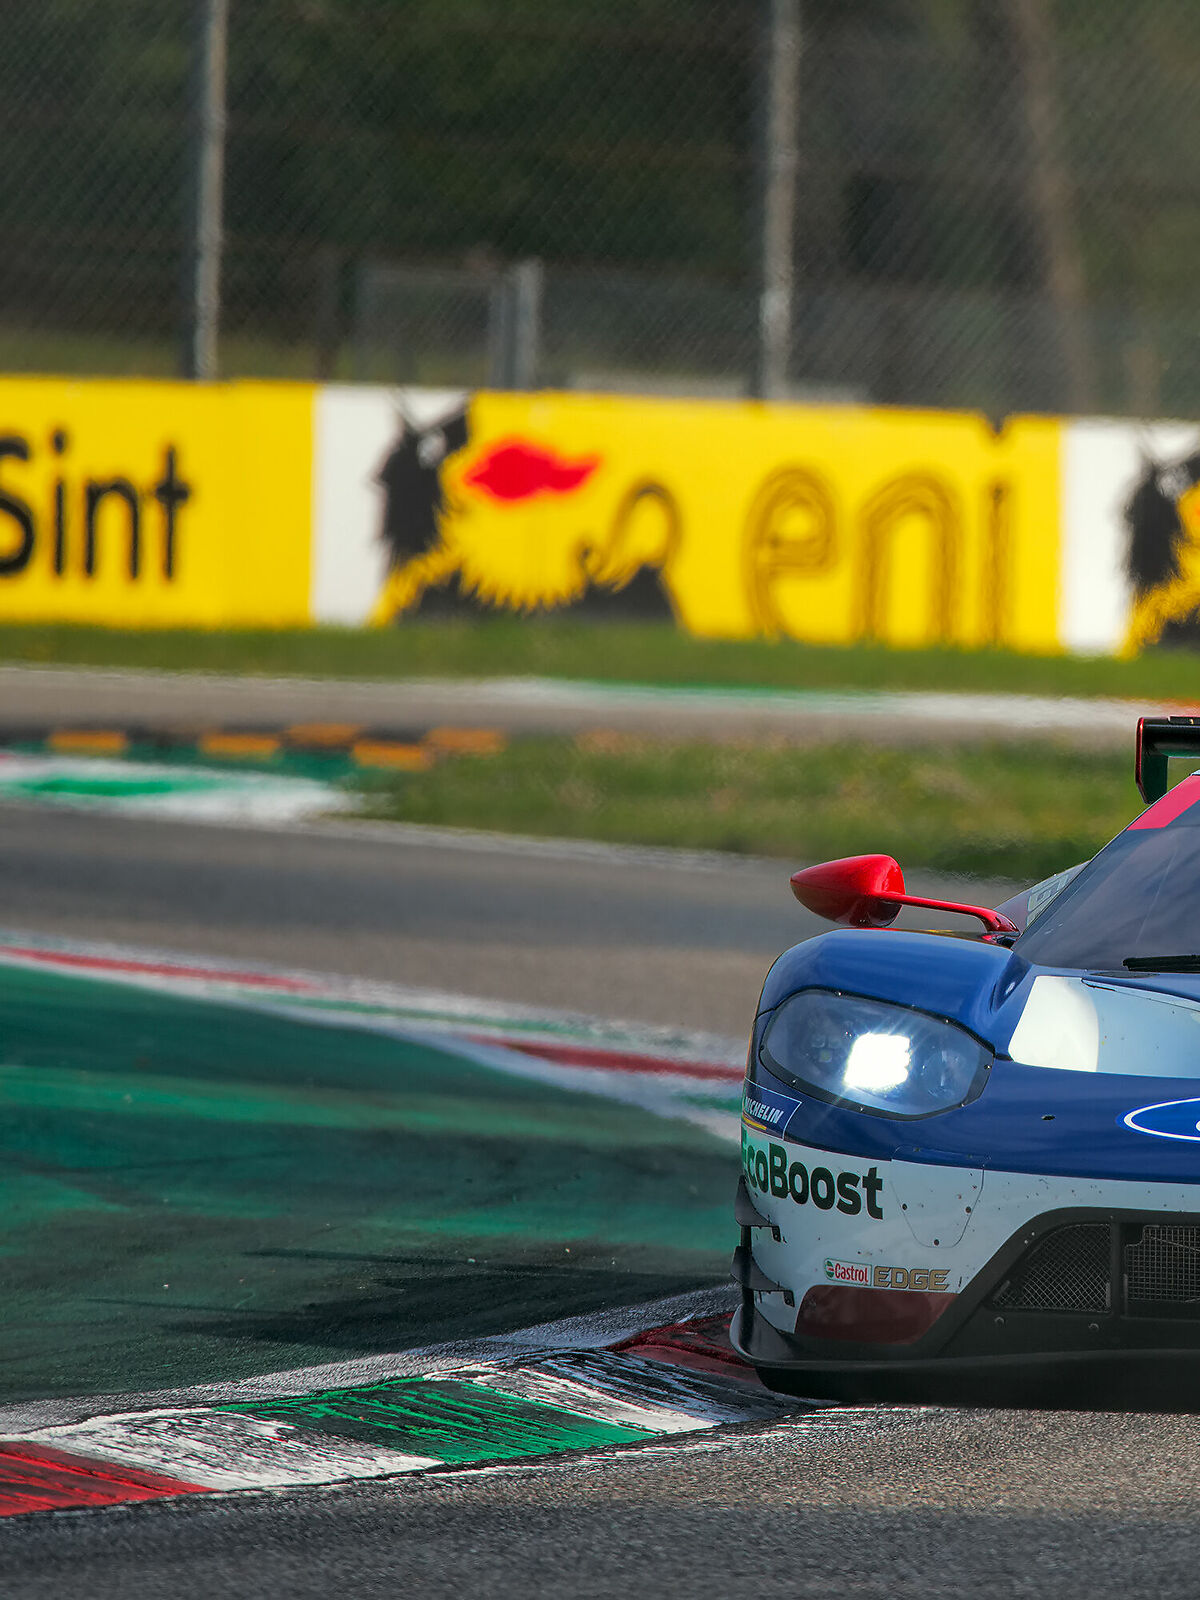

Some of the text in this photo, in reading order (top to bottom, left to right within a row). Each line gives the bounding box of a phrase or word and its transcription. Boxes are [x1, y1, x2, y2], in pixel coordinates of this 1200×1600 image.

[744, 463, 1011, 643] eni
[835, 1263, 951, 1291] Castrol EDGE
